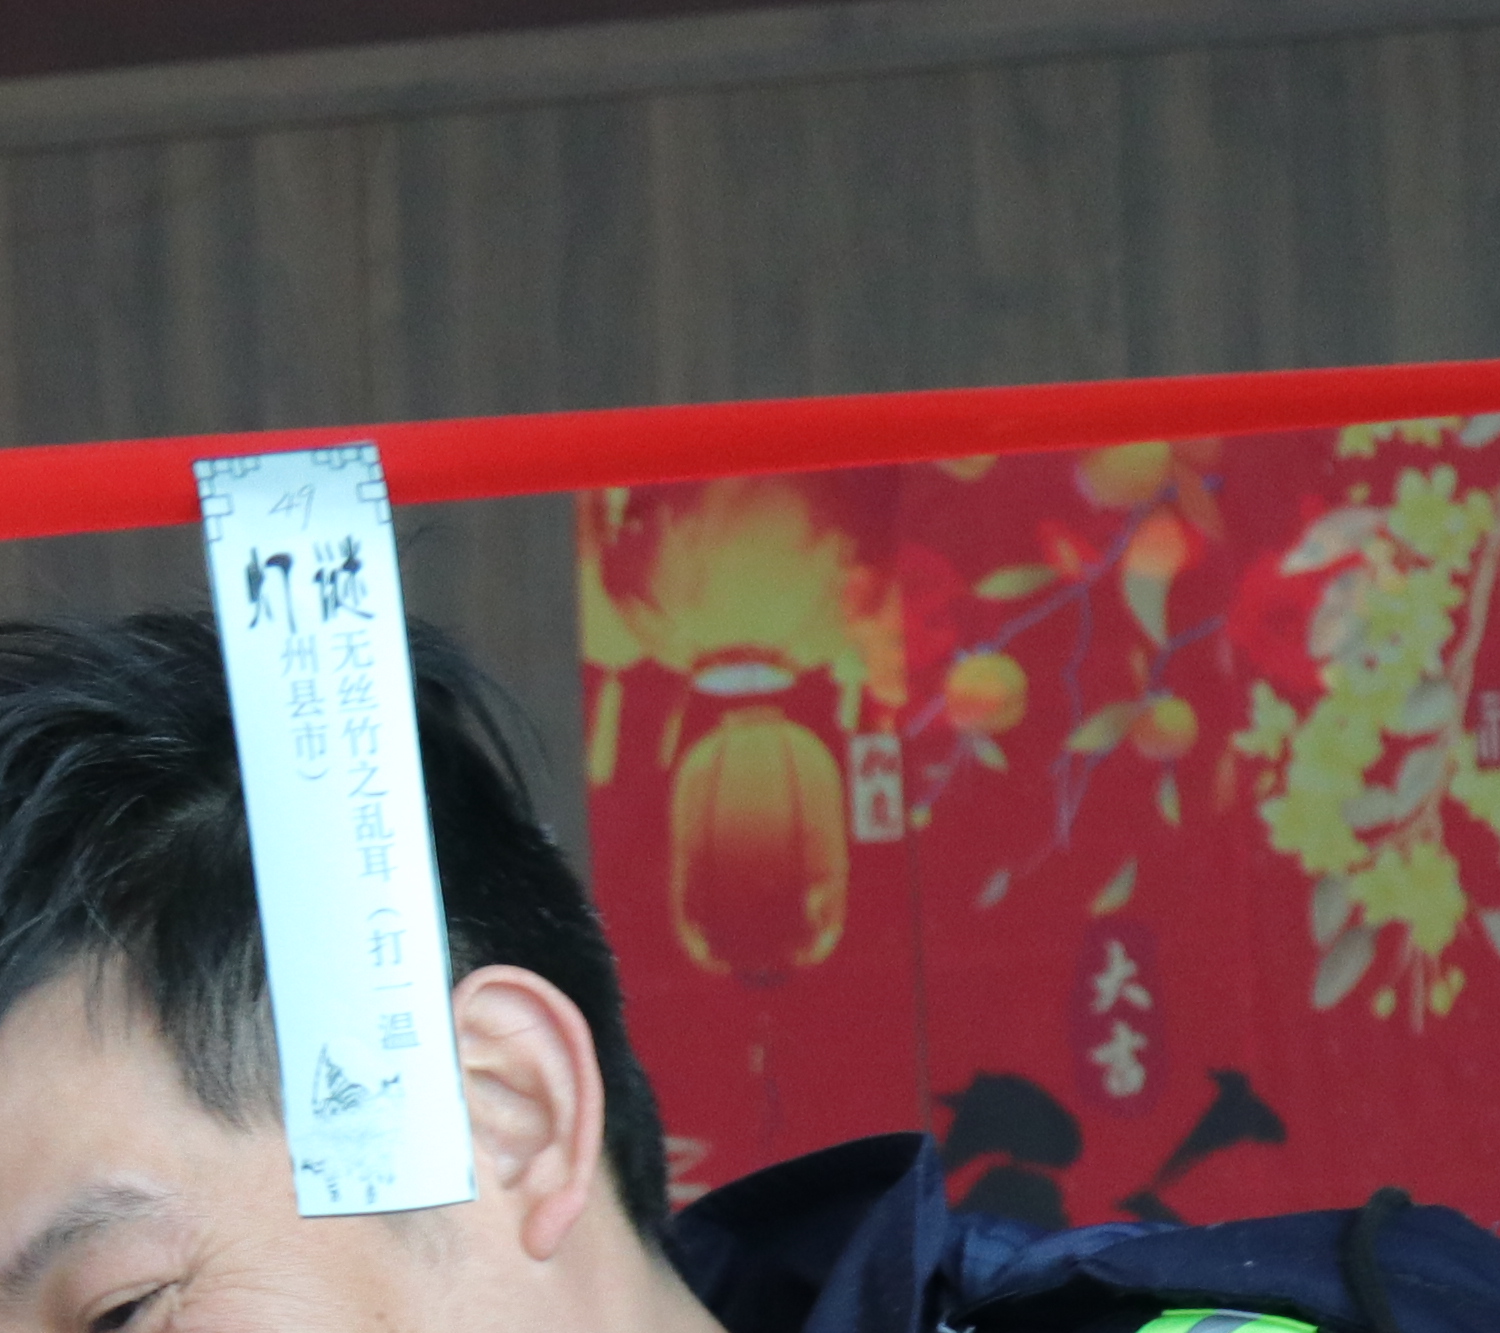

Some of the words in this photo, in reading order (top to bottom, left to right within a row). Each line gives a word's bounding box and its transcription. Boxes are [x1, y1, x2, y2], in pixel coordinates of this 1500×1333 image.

[269, 484, 316, 530] 49
[245, 534, 374, 634] 灯谜
[1089, 938, 1154, 1098] 大吉
